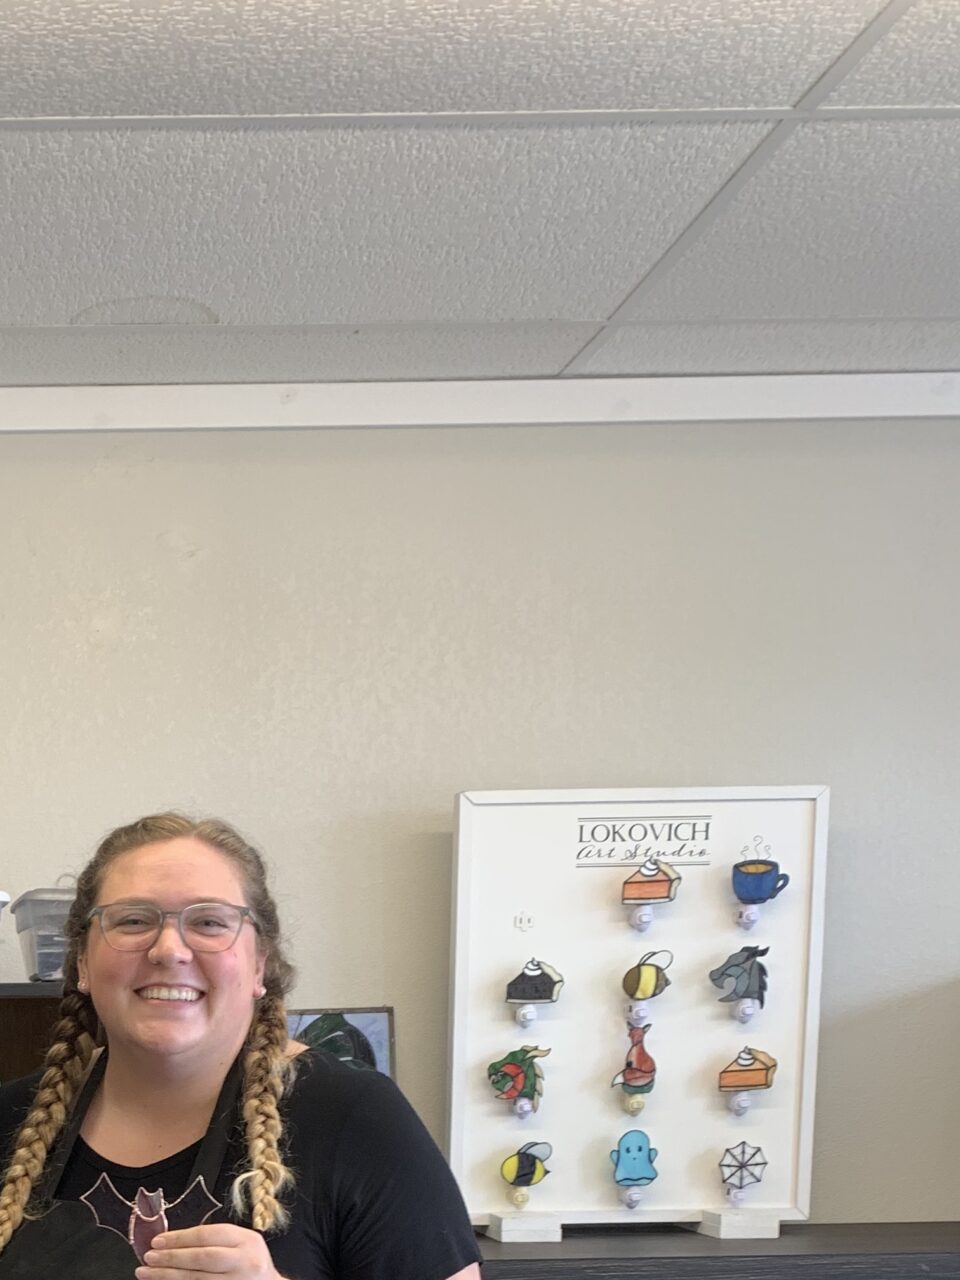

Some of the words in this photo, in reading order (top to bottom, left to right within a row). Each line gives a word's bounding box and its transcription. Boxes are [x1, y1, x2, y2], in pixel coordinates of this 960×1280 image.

[578, 822, 711, 843] LOKOVICH
[576, 844, 617, 860] Art
[622, 843, 712, 862] Studio
